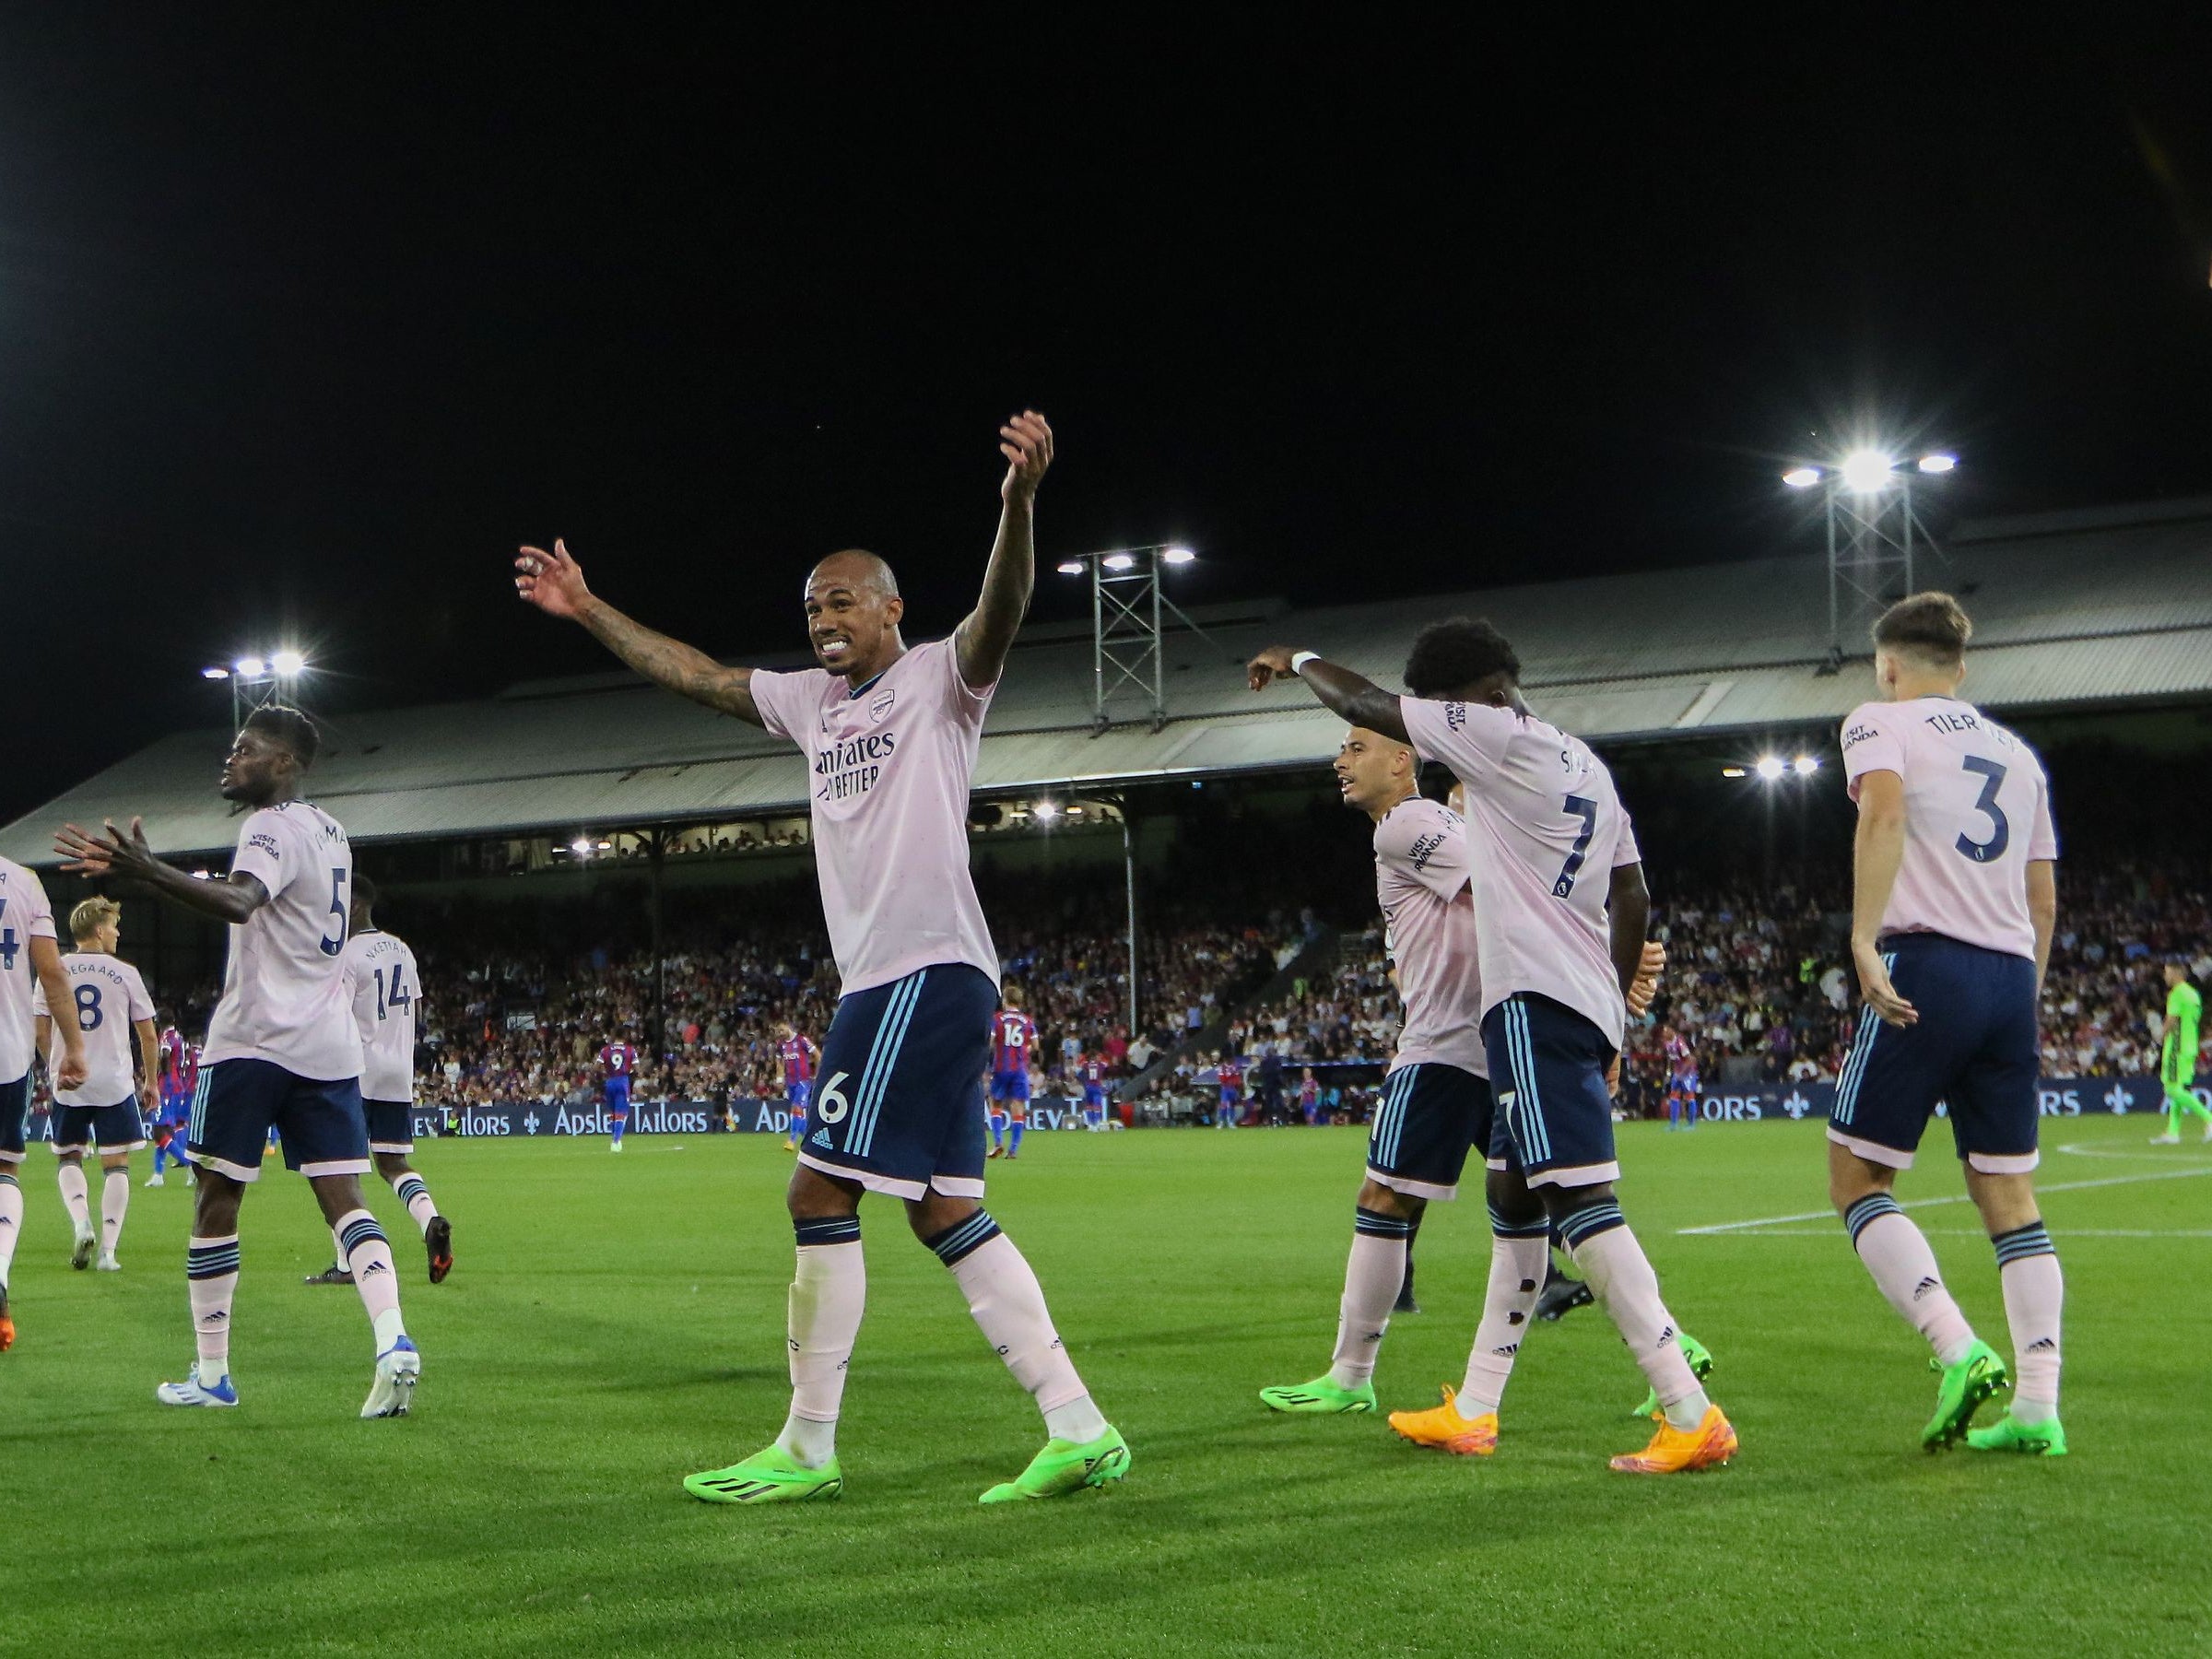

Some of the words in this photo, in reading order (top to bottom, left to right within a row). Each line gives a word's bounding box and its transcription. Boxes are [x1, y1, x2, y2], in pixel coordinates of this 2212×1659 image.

[816, 733, 895, 774] miates
[1843, 730, 1878, 752] ANDA
[835, 765, 879, 799] BETTER
[1955, 755, 2009, 863] 3
[1408, 833, 1430, 859] VISIT
[1552, 795, 1598, 900] 7
[320, 868, 347, 956] 5
[75, 984, 103, 1031] 8
[374, 964, 411, 1020] 14
[1005, 1024, 1024, 1047] 16
[611, 1053, 624, 1070] 9
[818, 1072, 849, 1124] 6
[1499, 1091, 1516, 1143] 7
[439, 1107, 510, 1135] TILORS
